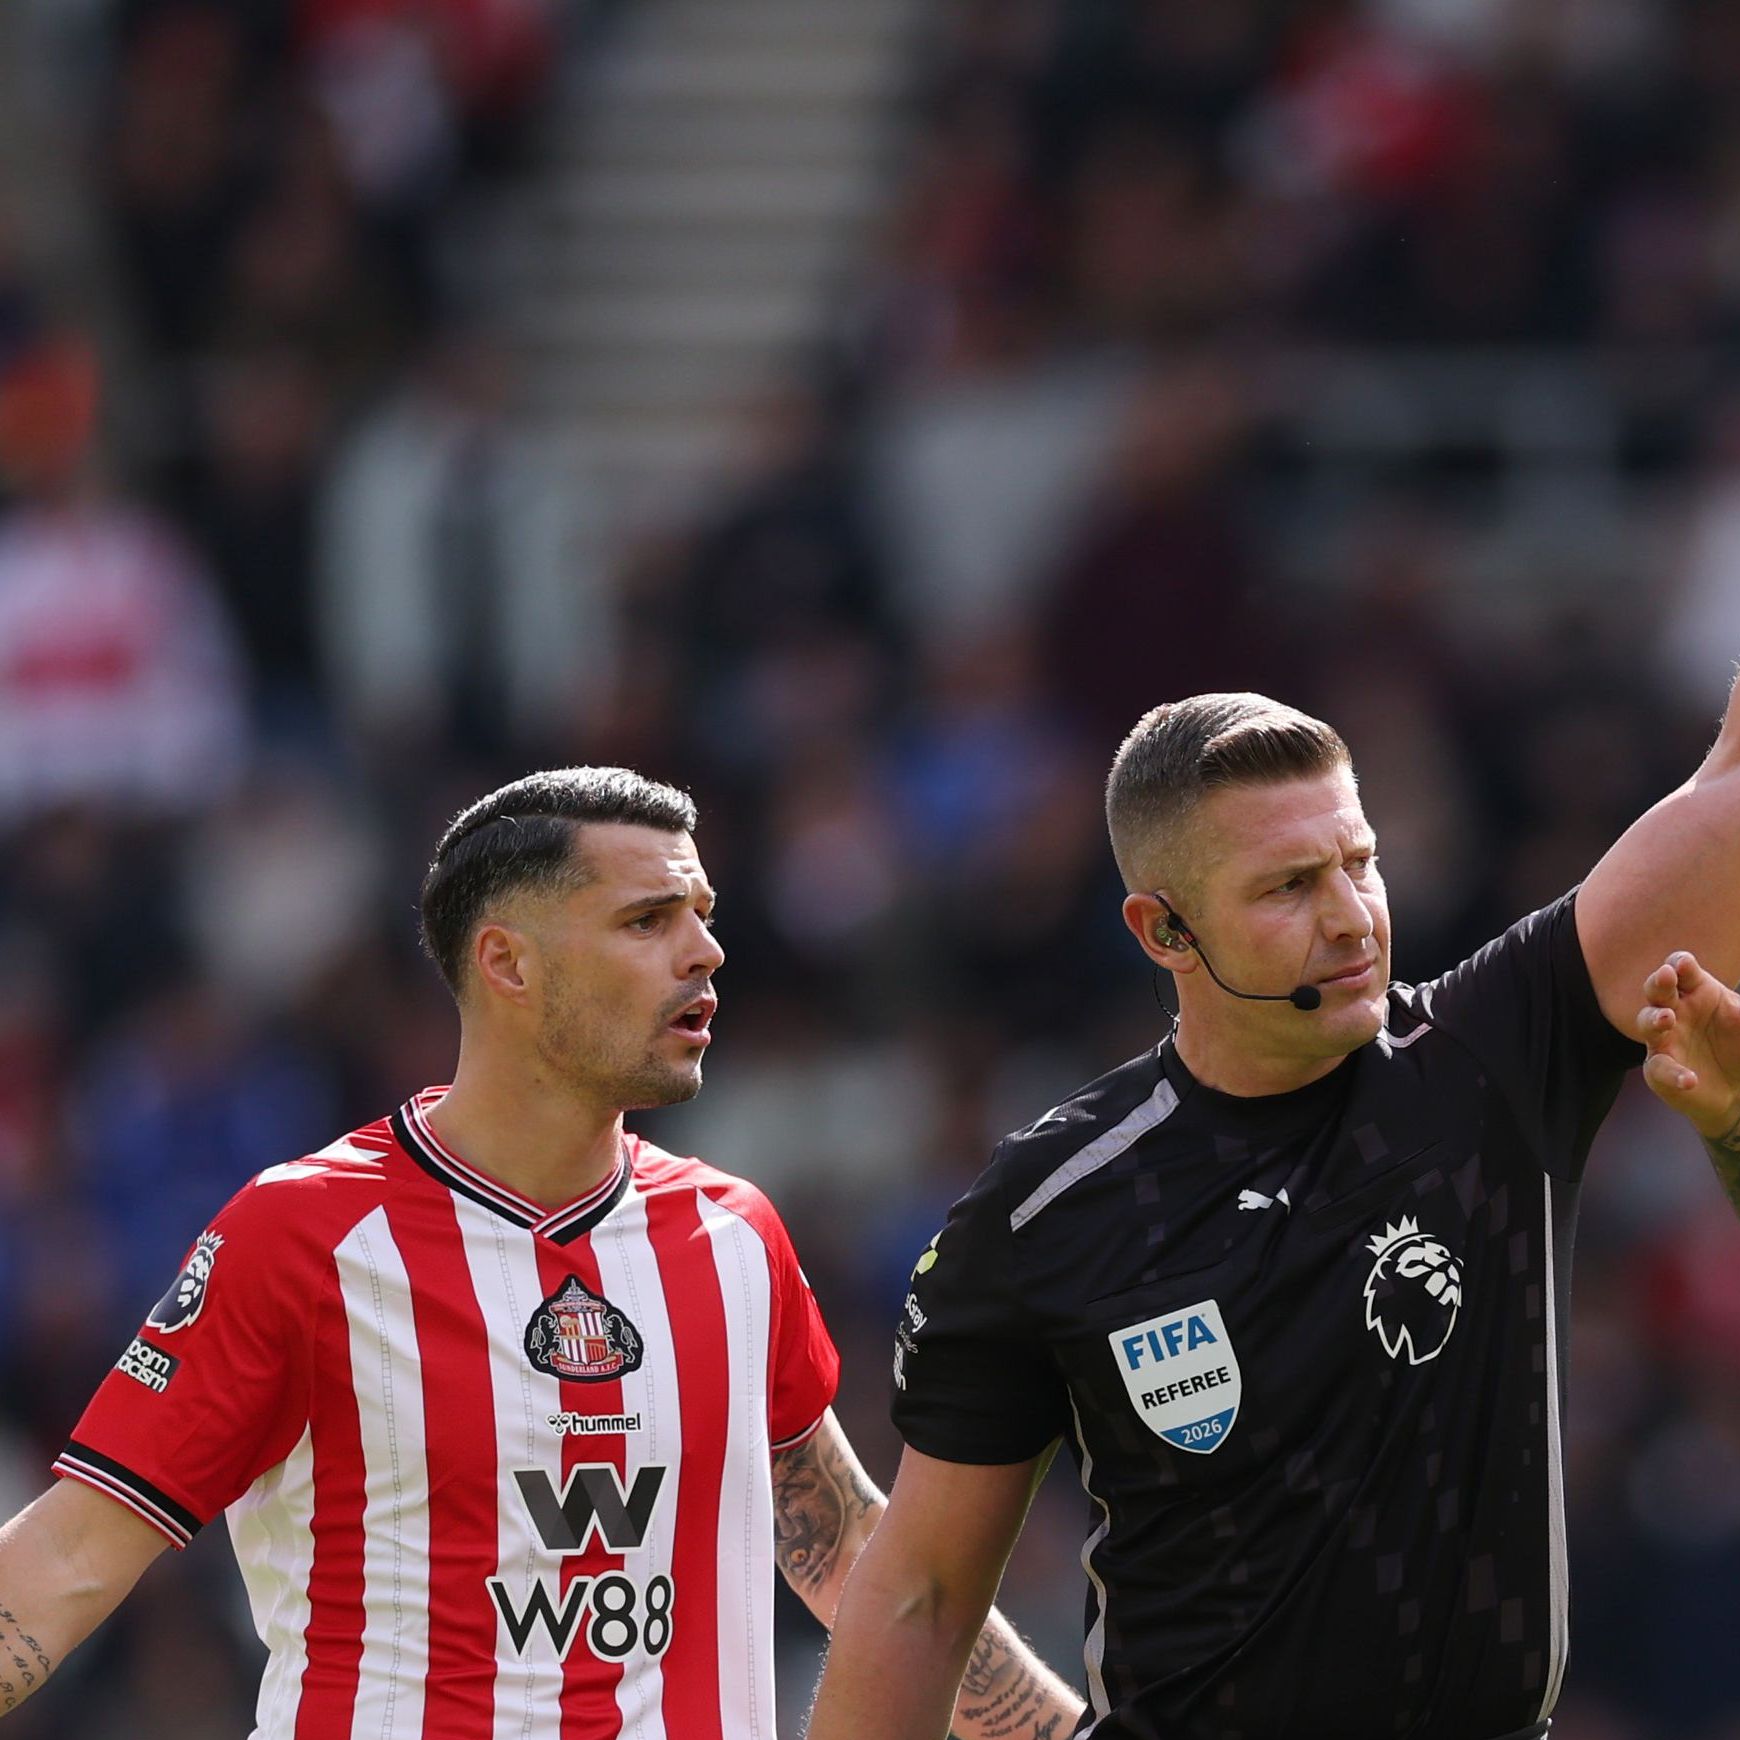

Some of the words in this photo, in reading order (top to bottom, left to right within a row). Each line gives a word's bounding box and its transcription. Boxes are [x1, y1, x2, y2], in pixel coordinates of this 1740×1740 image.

[128, 1340, 170, 1374] oom
[1121, 1315, 1218, 1371] FIFA
[117, 1355, 168, 1393] acism
[1141, 1366, 1231, 1410] REFEREE
[572, 1412, 641, 1433] hummel
[1181, 1418, 1222, 1444] 2026
[490, 1574, 672, 1657] W88
